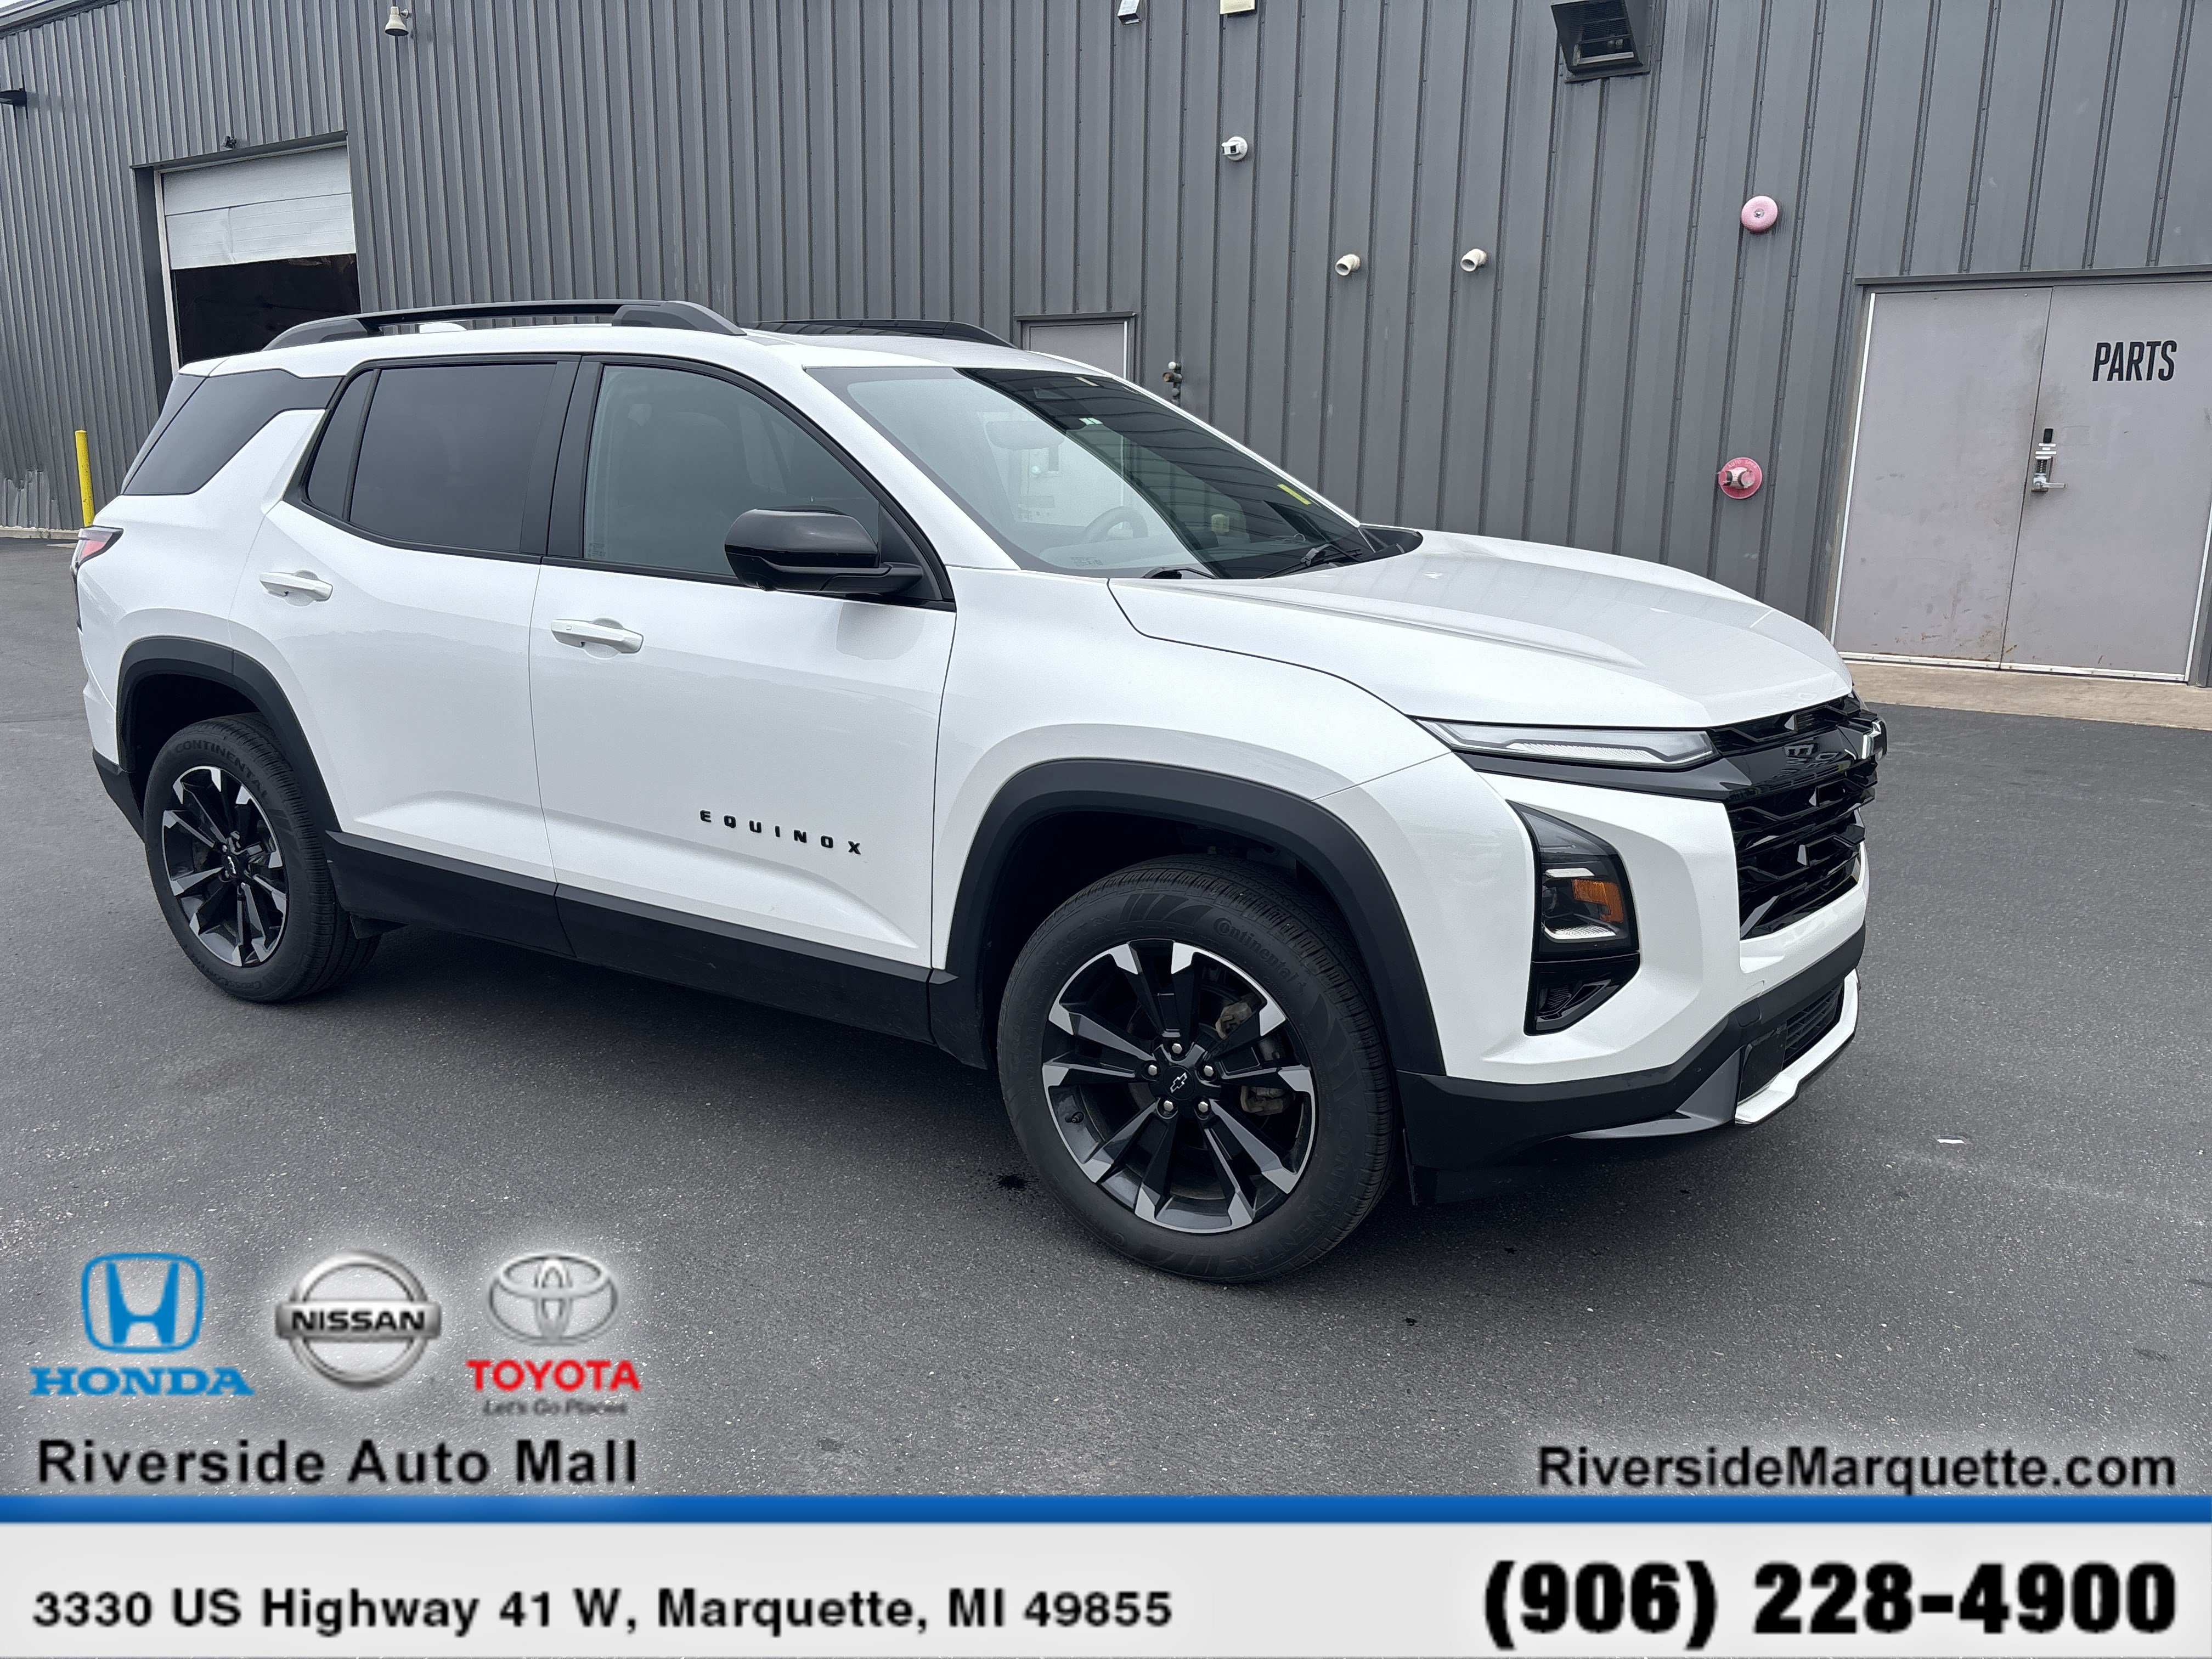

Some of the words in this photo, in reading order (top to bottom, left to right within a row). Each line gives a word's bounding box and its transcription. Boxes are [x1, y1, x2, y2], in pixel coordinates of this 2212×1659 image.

[2092, 340, 2177, 382] PARTS
[699, 810, 861, 855] EQUINOX
[1212, 917, 1300, 983] Continental
